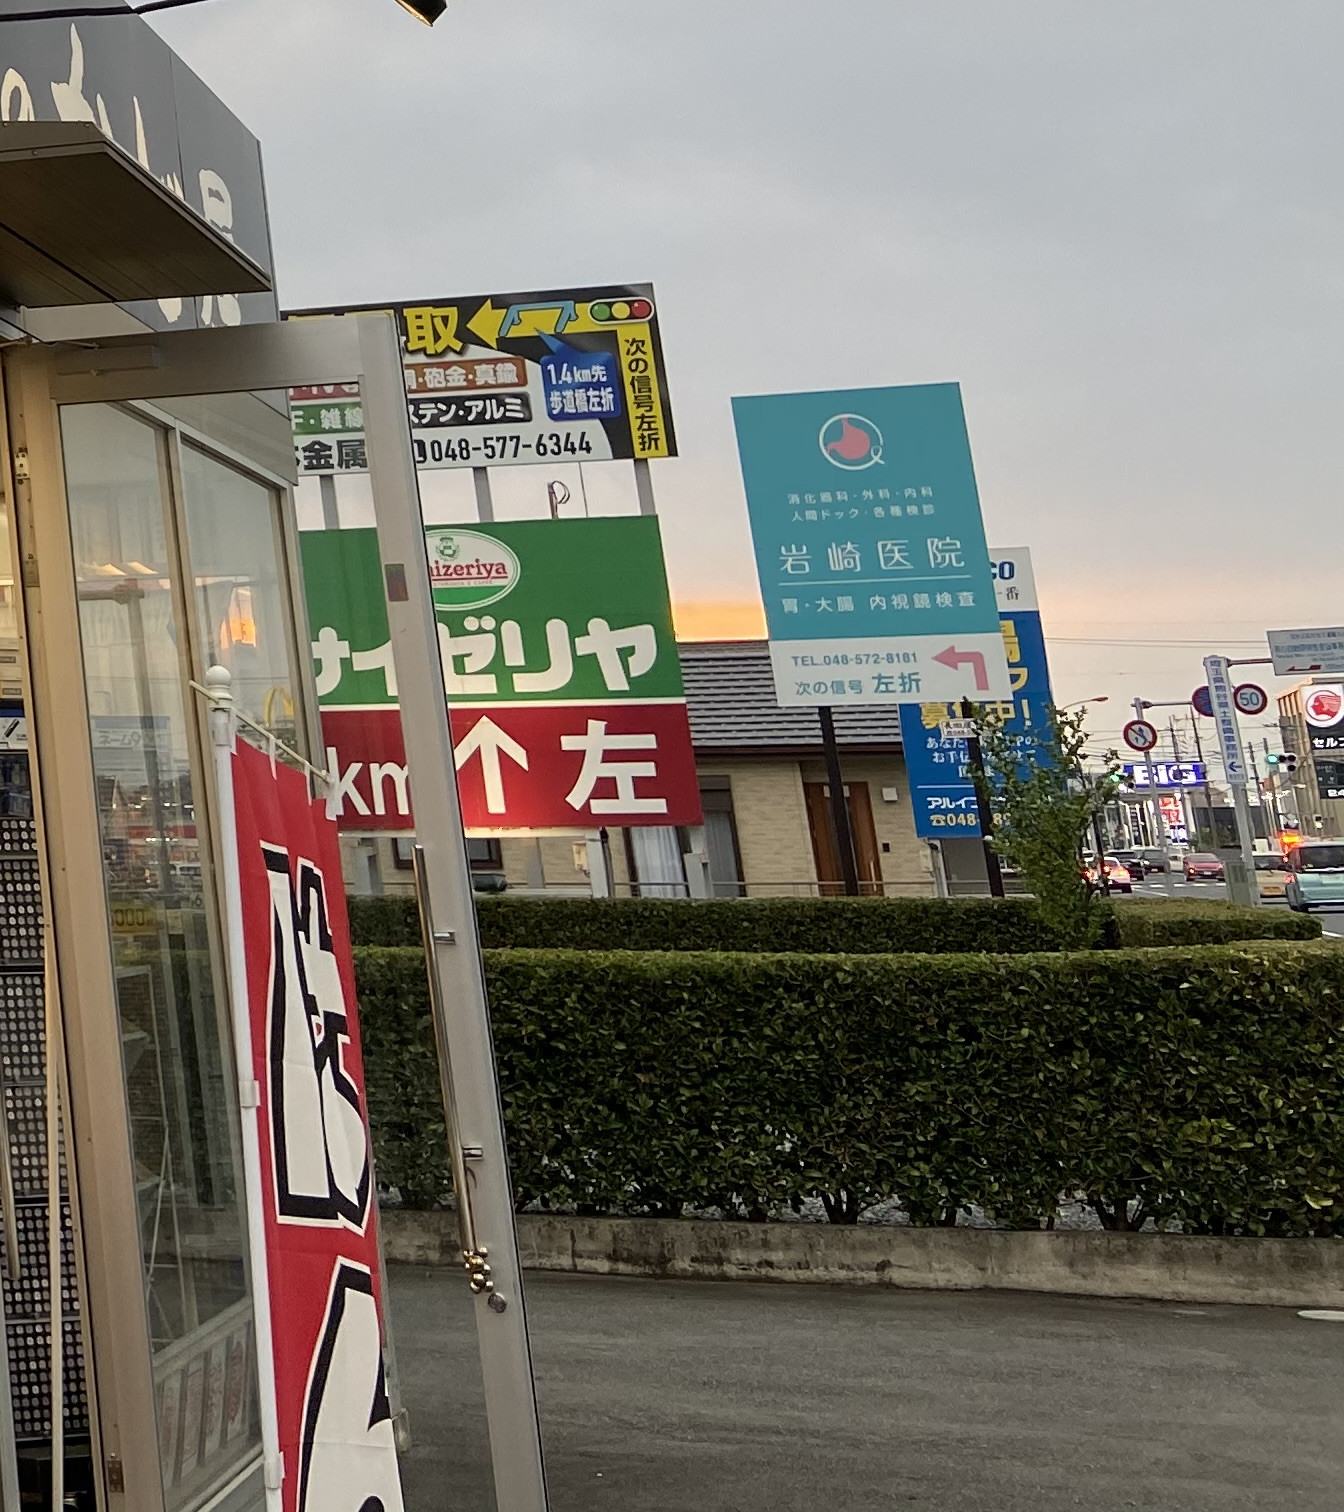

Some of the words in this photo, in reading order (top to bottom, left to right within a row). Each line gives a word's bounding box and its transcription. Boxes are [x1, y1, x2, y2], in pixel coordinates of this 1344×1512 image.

[548, 387, 615, 415] 歩道橋左折
[623, 336, 661, 452] 次の信号左折
[294, 439, 368, 471] 金属
[430, 430, 593, 465] 048-577-6344
[778, 536, 967, 575] 岩崎医院
[781, 594, 855, 615] 胃・大腸
[869, 591, 977, 612] 内視鏡検査
[795, 678, 865, 697] 次の信号
[872, 671, 923, 695] 左折
[1238, 691, 1261, 708] 50
[559, 718, 669, 815] 左
[1133, 764, 1198, 785] BIG
